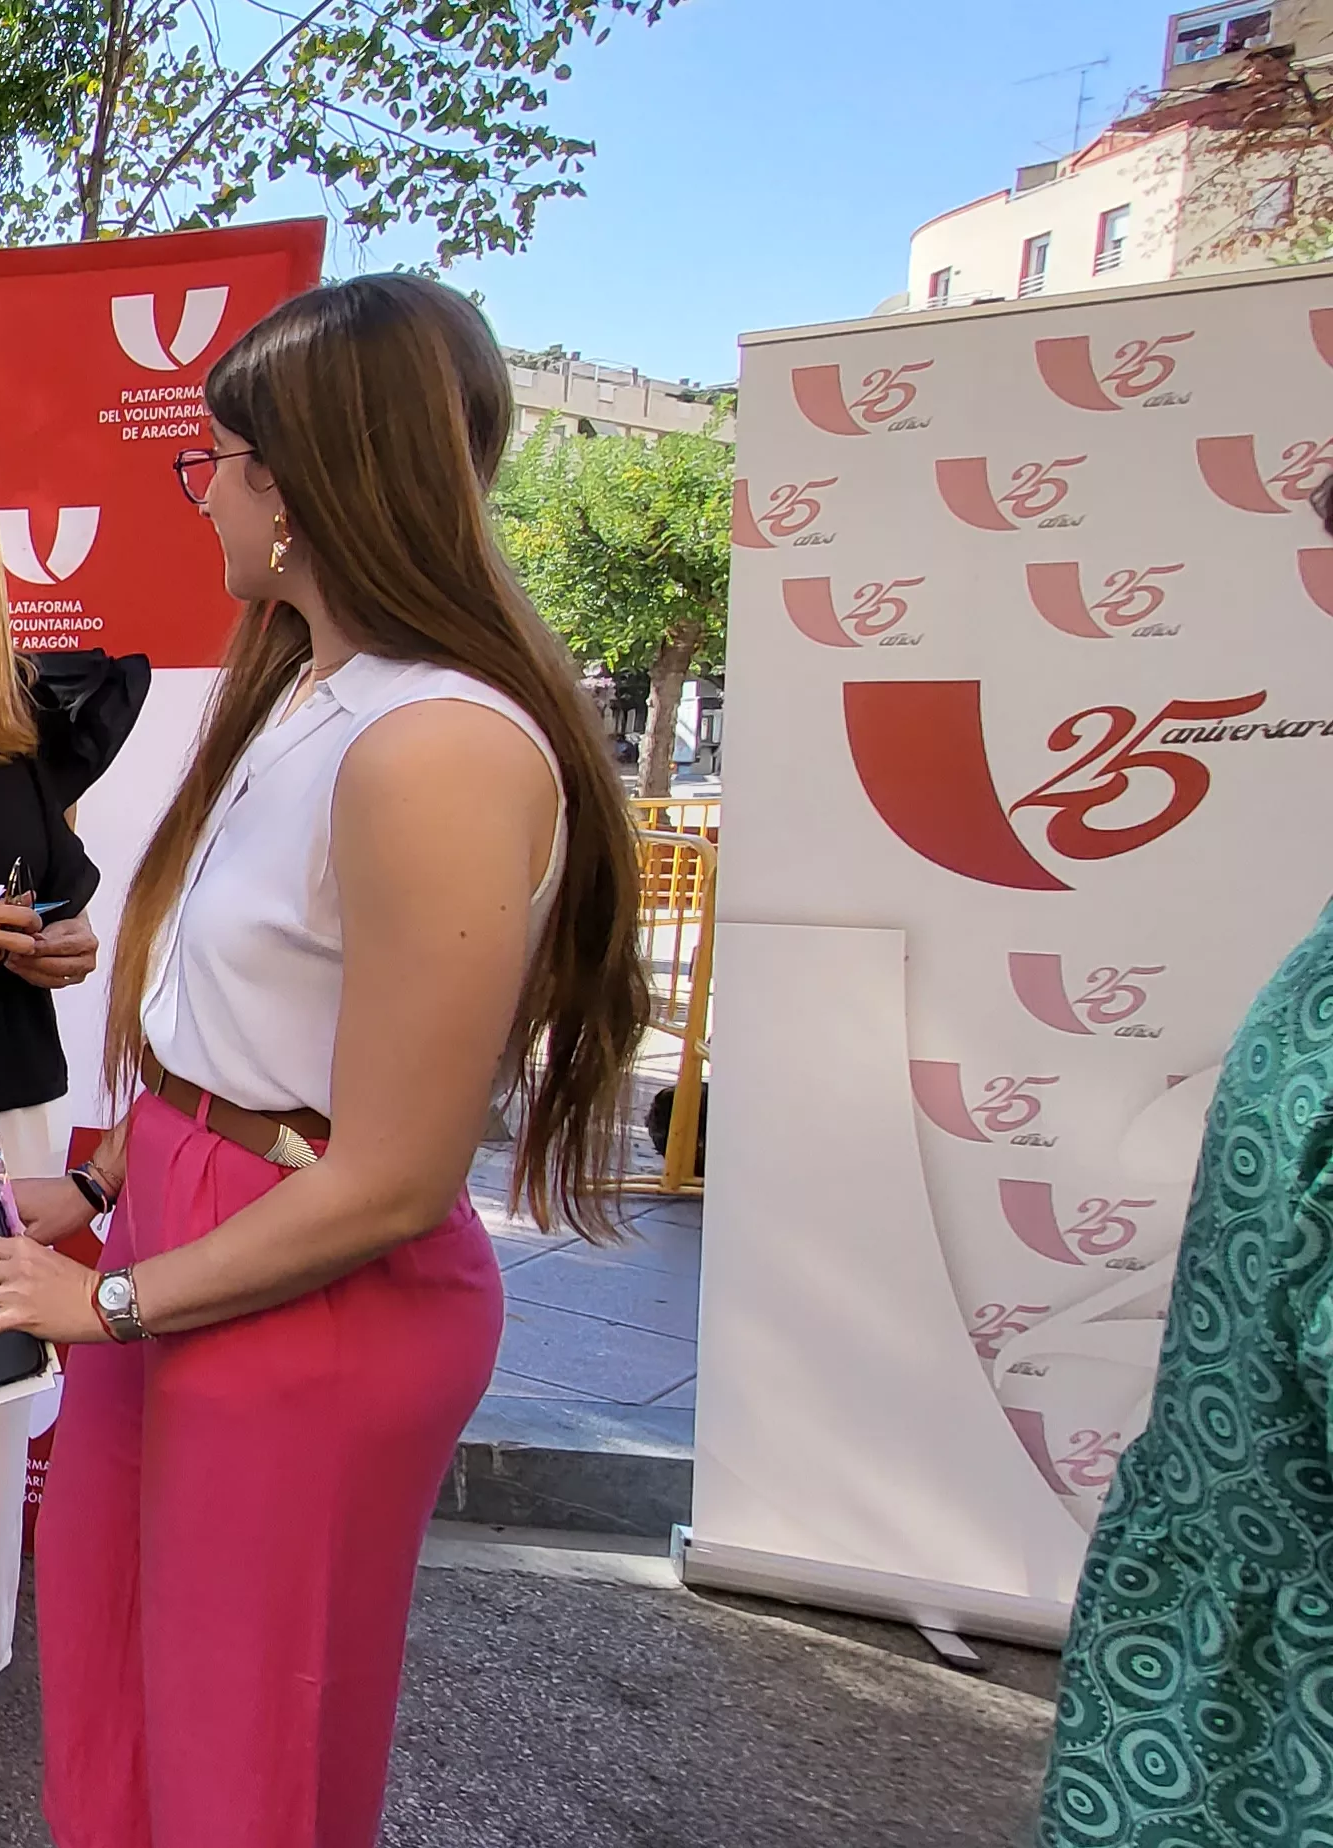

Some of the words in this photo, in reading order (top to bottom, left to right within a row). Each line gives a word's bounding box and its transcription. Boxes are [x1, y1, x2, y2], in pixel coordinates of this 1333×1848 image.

[849, 358, 934, 423] 25
[1100, 330, 1195, 398] 25
[99, 410, 121, 423] DEL
[124, 404, 209, 422] VOLUNTARIA
[121, 386, 204, 404] PLATAFORMA
[122, 427, 138, 440] DE
[141, 420, 200, 439] ARAGÓN
[757, 476, 838, 537] 25
[997, 454, 1087, 518] 25
[9, 600, 83, 614] LATAFORMA
[841, 576, 925, 636] 25
[1090, 563, 1185, 626] 25
[22, 633, 79, 649] ARAGÓN
[1009, 690, 1267, 861] 25
[1073, 965, 1166, 1024] 25
[972, 1075, 1060, 1132] 25
[1063, 1198, 1157, 1255] 25
